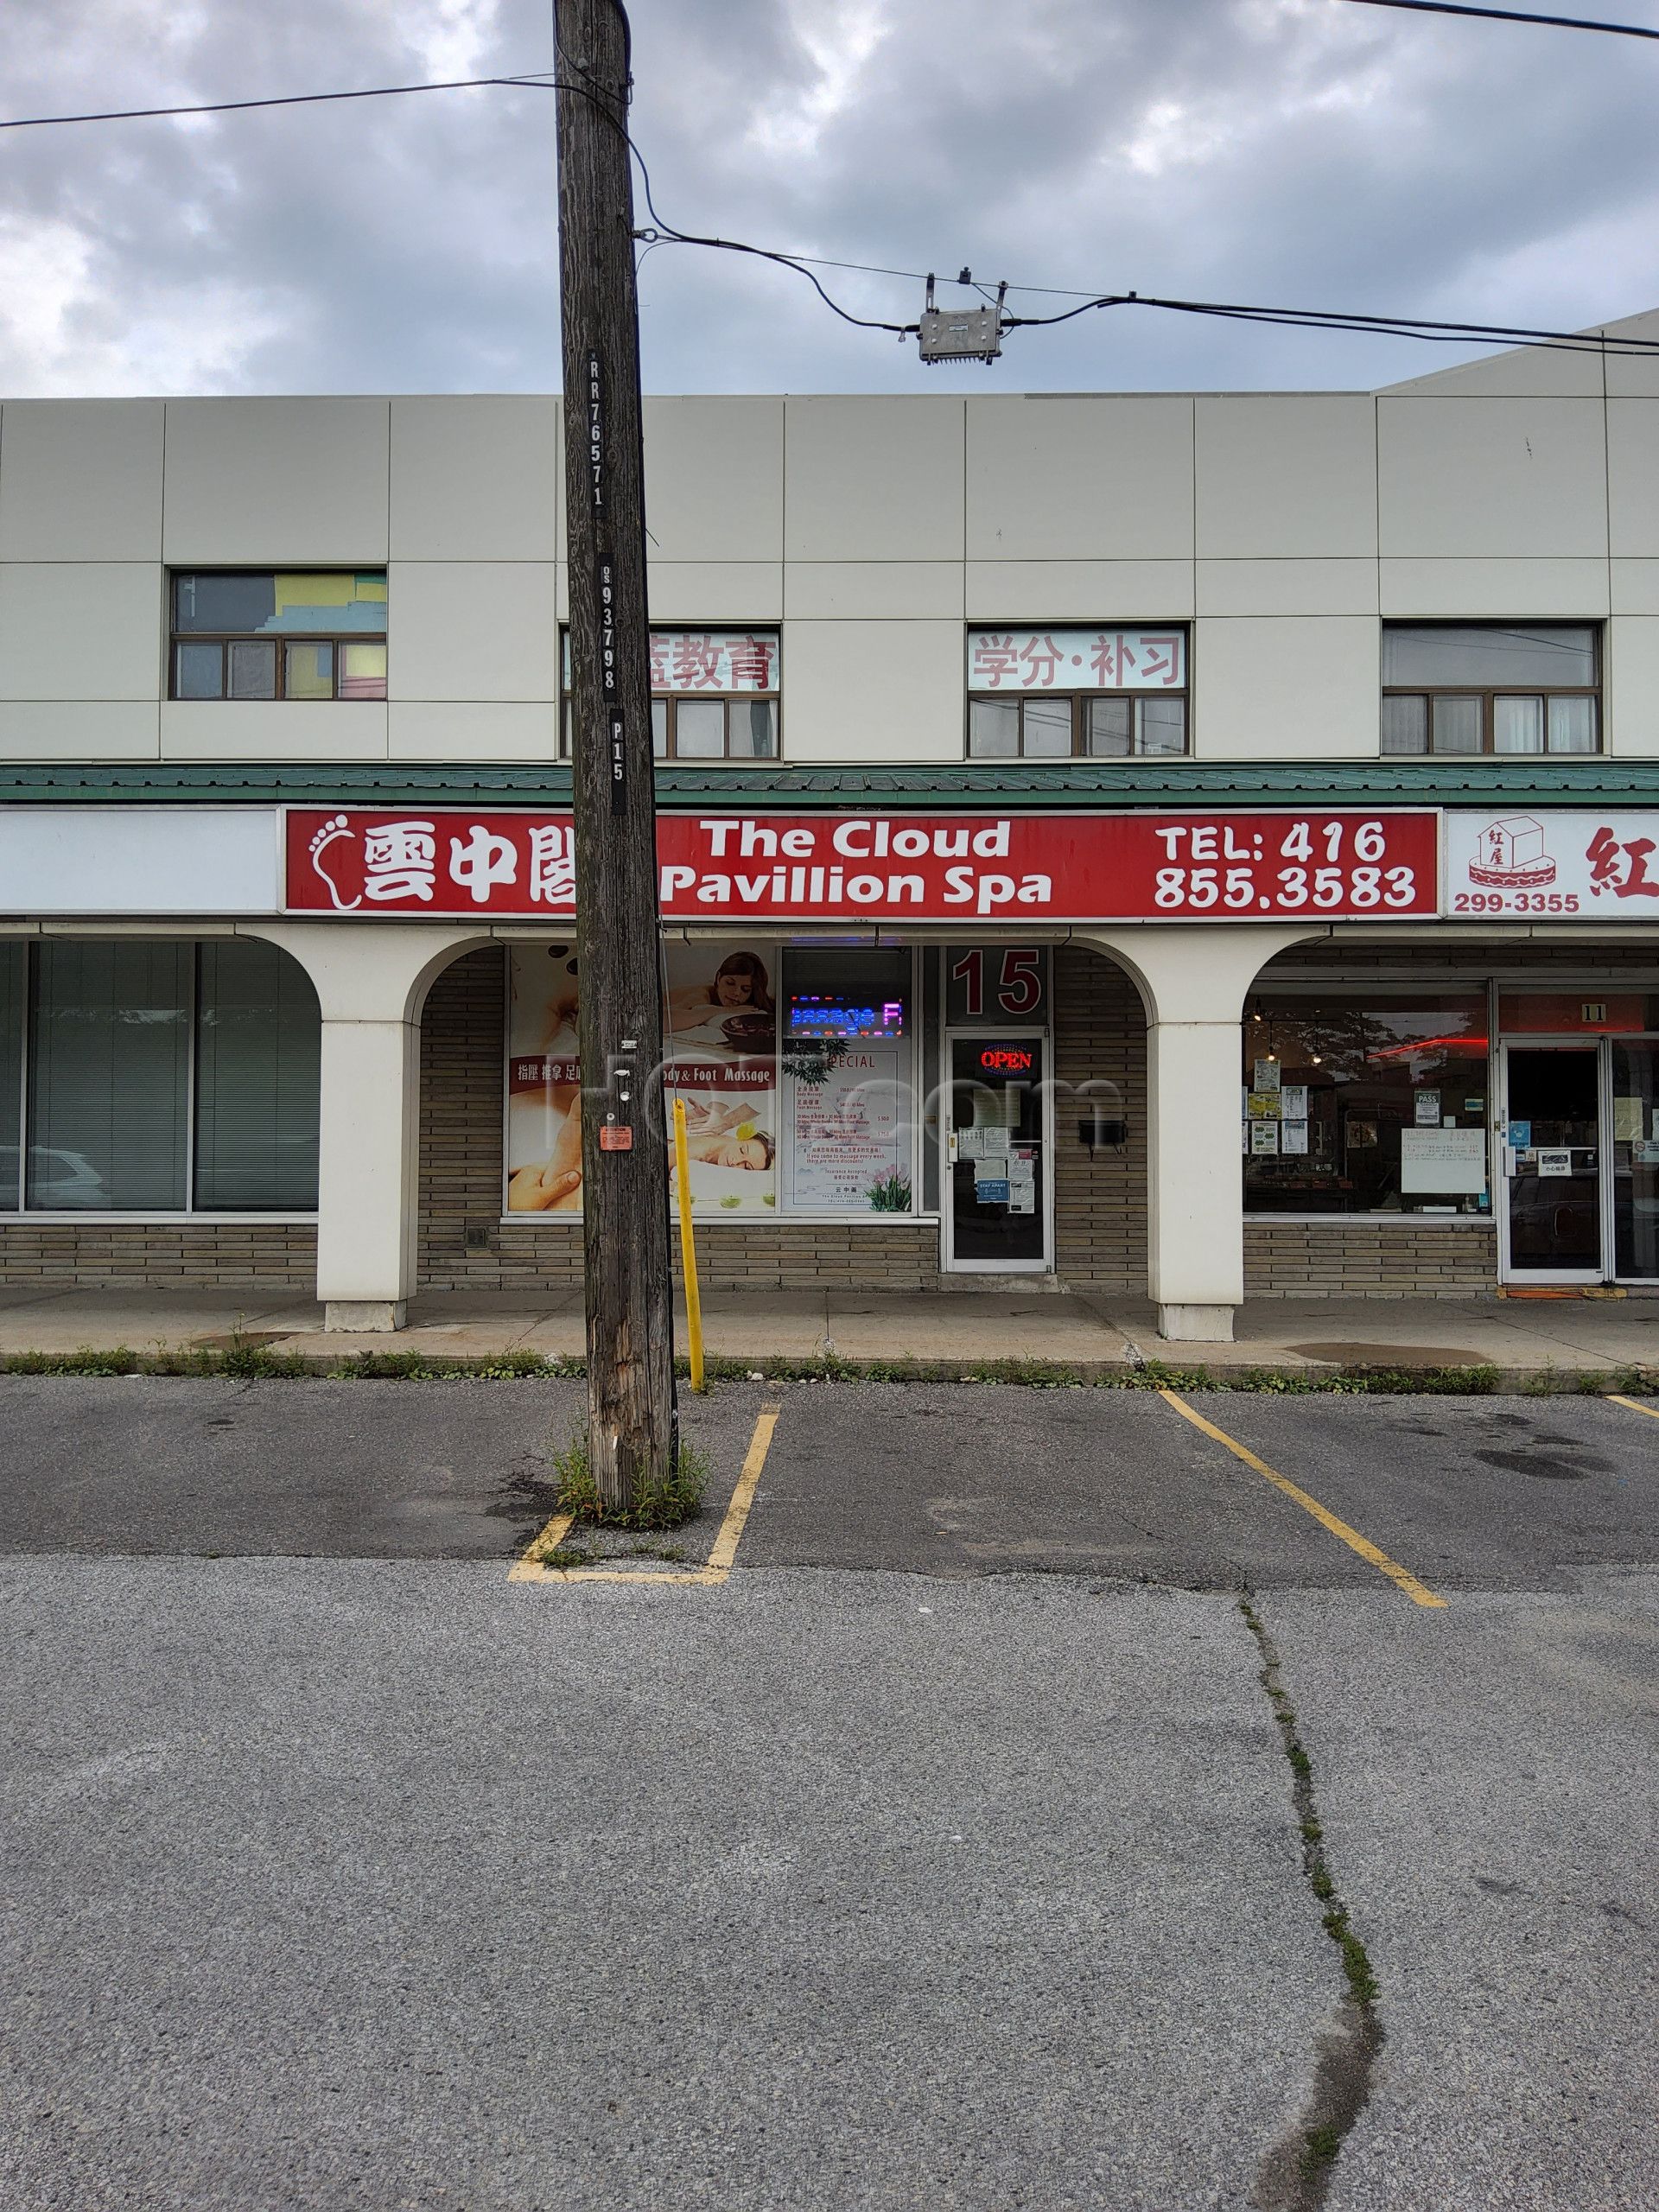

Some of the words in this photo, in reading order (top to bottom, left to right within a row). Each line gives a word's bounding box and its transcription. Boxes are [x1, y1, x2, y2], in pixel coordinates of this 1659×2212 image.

[590, 361, 602, 505] RR76571
[614, 722, 623, 779] P15
[700, 820, 815, 857] The
[832, 820, 1010, 857] Cloud
[1155, 826, 1263, 861] TEL:
[1281, 821, 1385, 862] 416
[1488, 830, 1504, 865] 紅屋
[1586, 827, 1659, 898] 紅
[660, 866, 925, 903] Pavillion
[944, 866, 1052, 914] Spa
[1154, 867, 1416, 909] 855.3583
[1454, 893, 1580, 912] 299-3355
[953, 950, 1041, 1014] 15
[1585, 1005, 1604, 1020] 11
[694, 1067, 717, 1081] Foot
[724, 1067, 770, 1083] Massage
[830, 1054, 875, 1068] PECIAL
[982, 1052, 1033, 1068] OPEN
